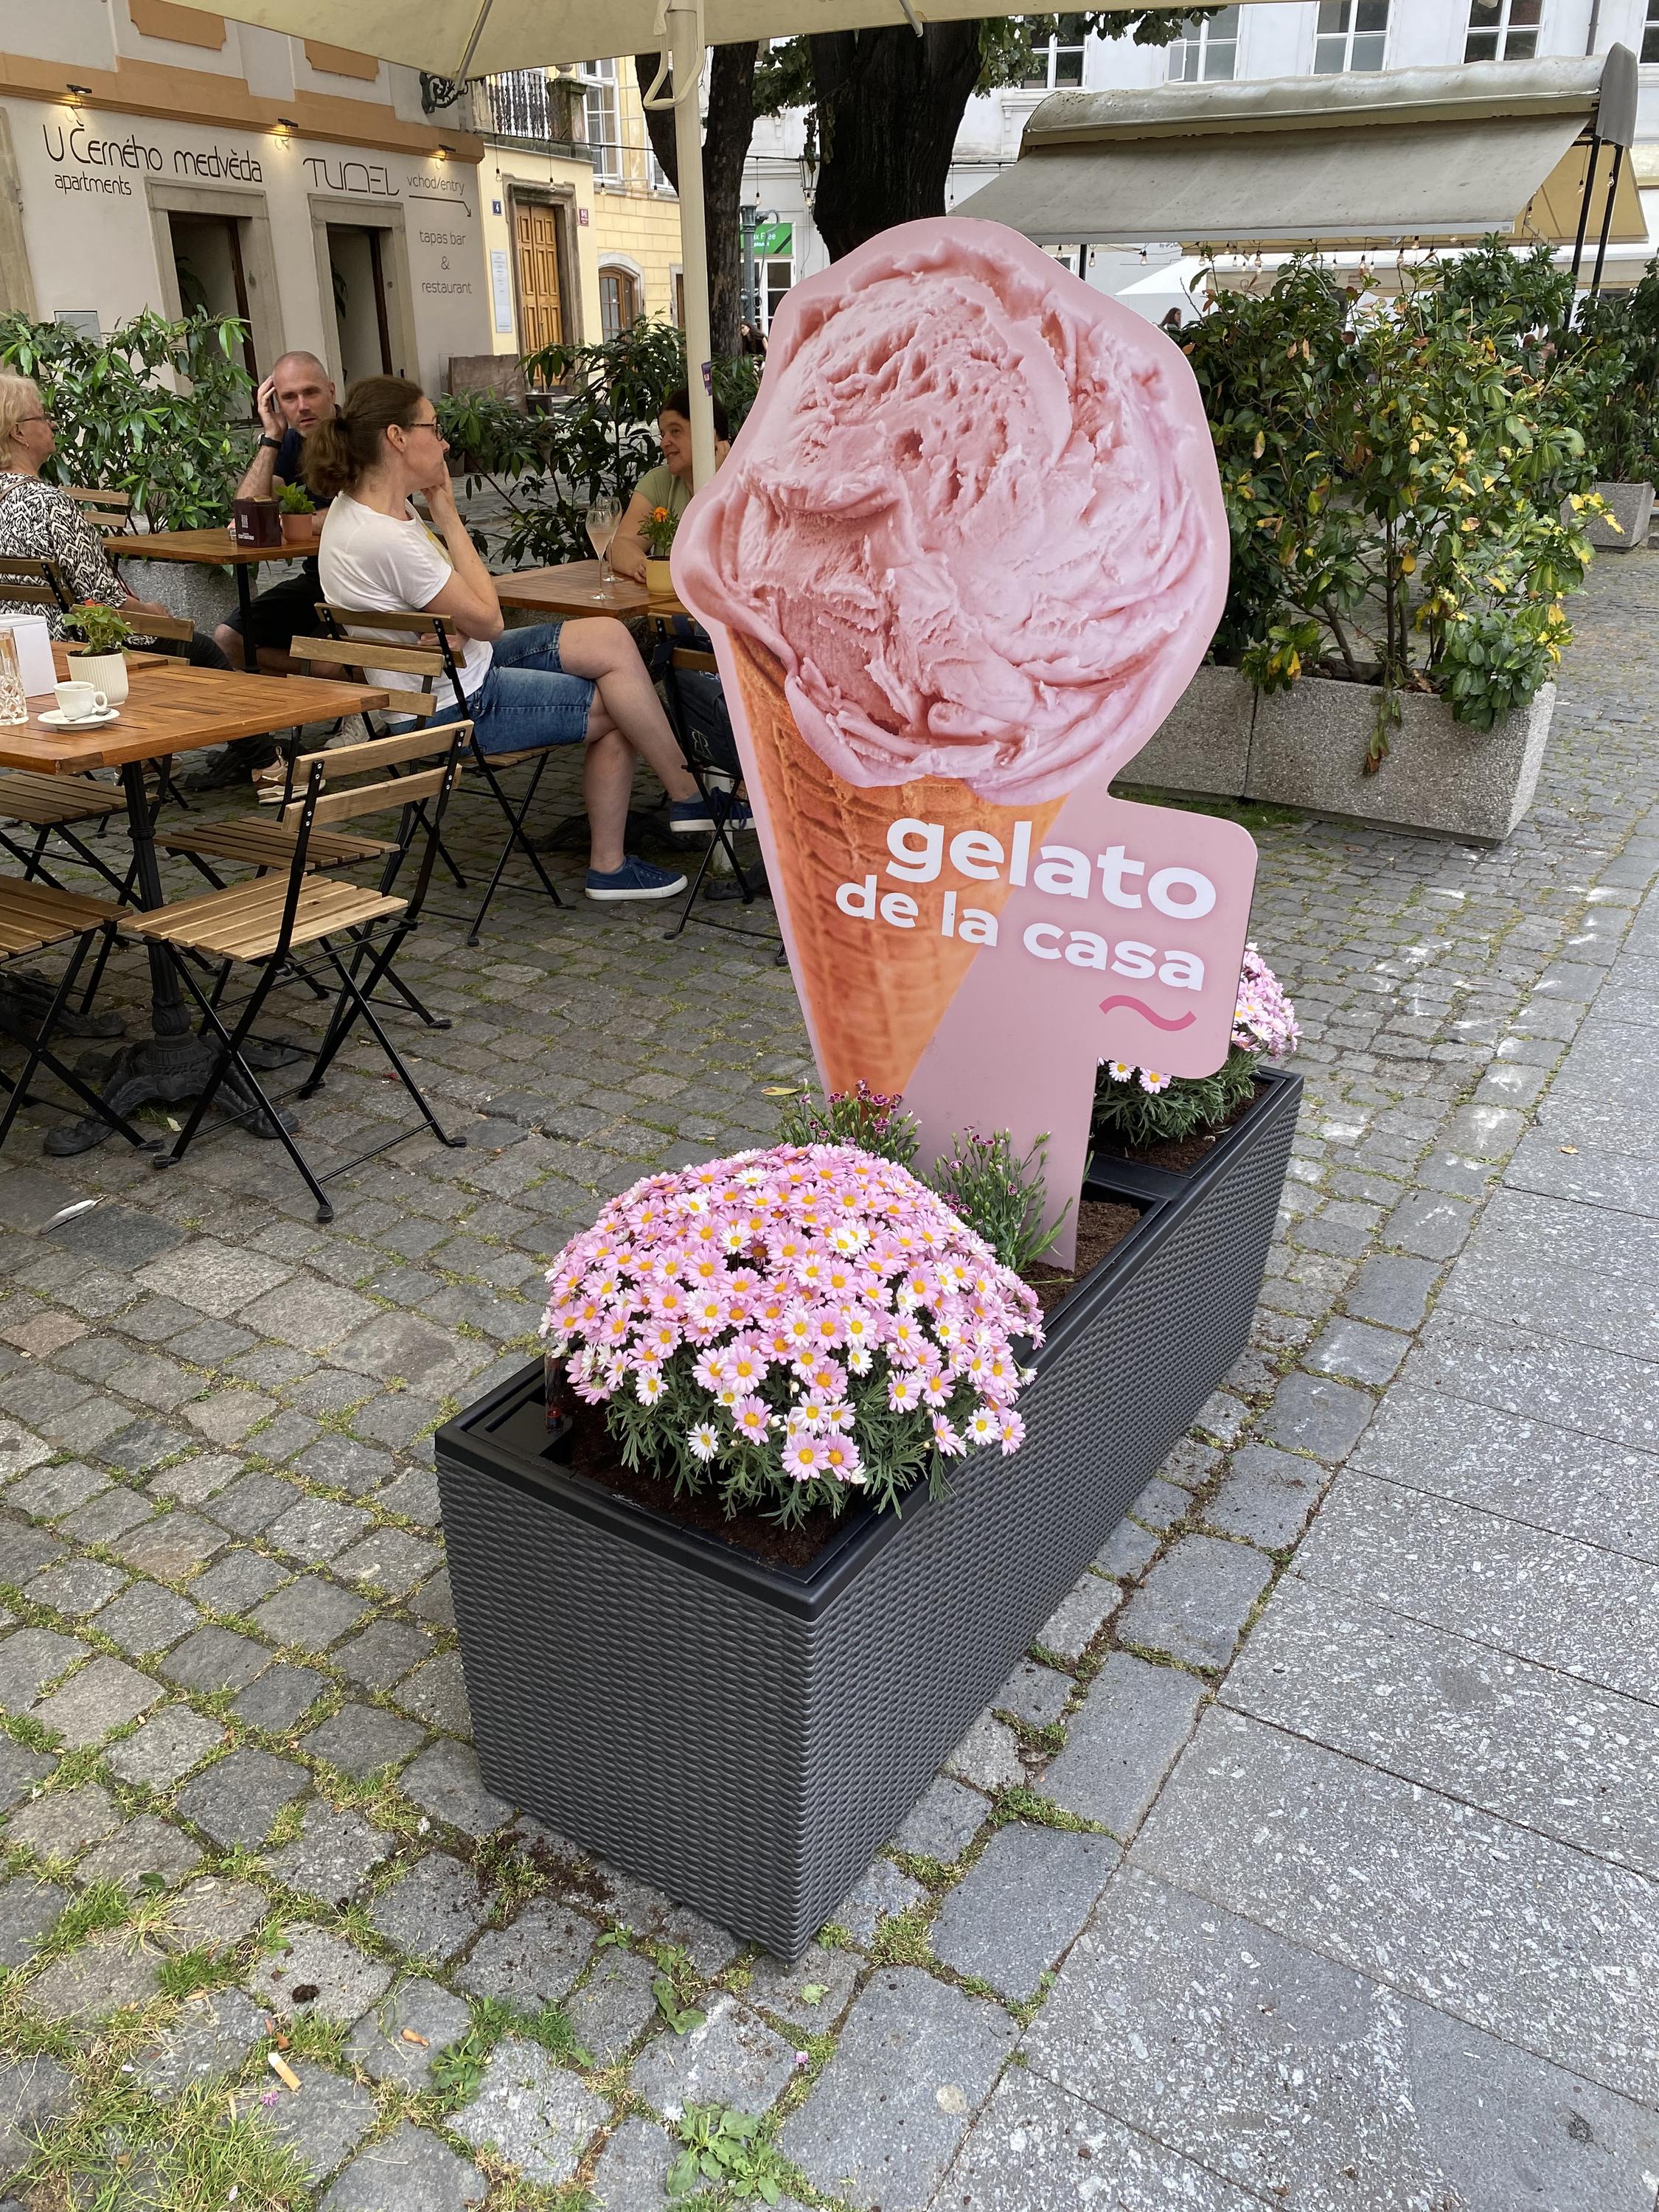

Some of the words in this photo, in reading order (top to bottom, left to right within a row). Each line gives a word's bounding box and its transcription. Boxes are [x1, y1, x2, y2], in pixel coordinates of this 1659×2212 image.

[43, 124, 65, 162] U
[70, 119, 163, 171] Černého
[173, 145, 263, 183] medvěda
[55, 171, 132, 195] apartments
[407, 174, 465, 195] vchod/entry
[419, 229, 448, 246] tapas
[450, 231, 466, 246] bar
[441, 256, 451, 270] &
[422, 281, 473, 294] restaurant
[886, 817, 1217, 920] gelato
[835, 874, 919, 928] de
[942, 891, 999, 947] la
[1023, 922, 1206, 992] casa
